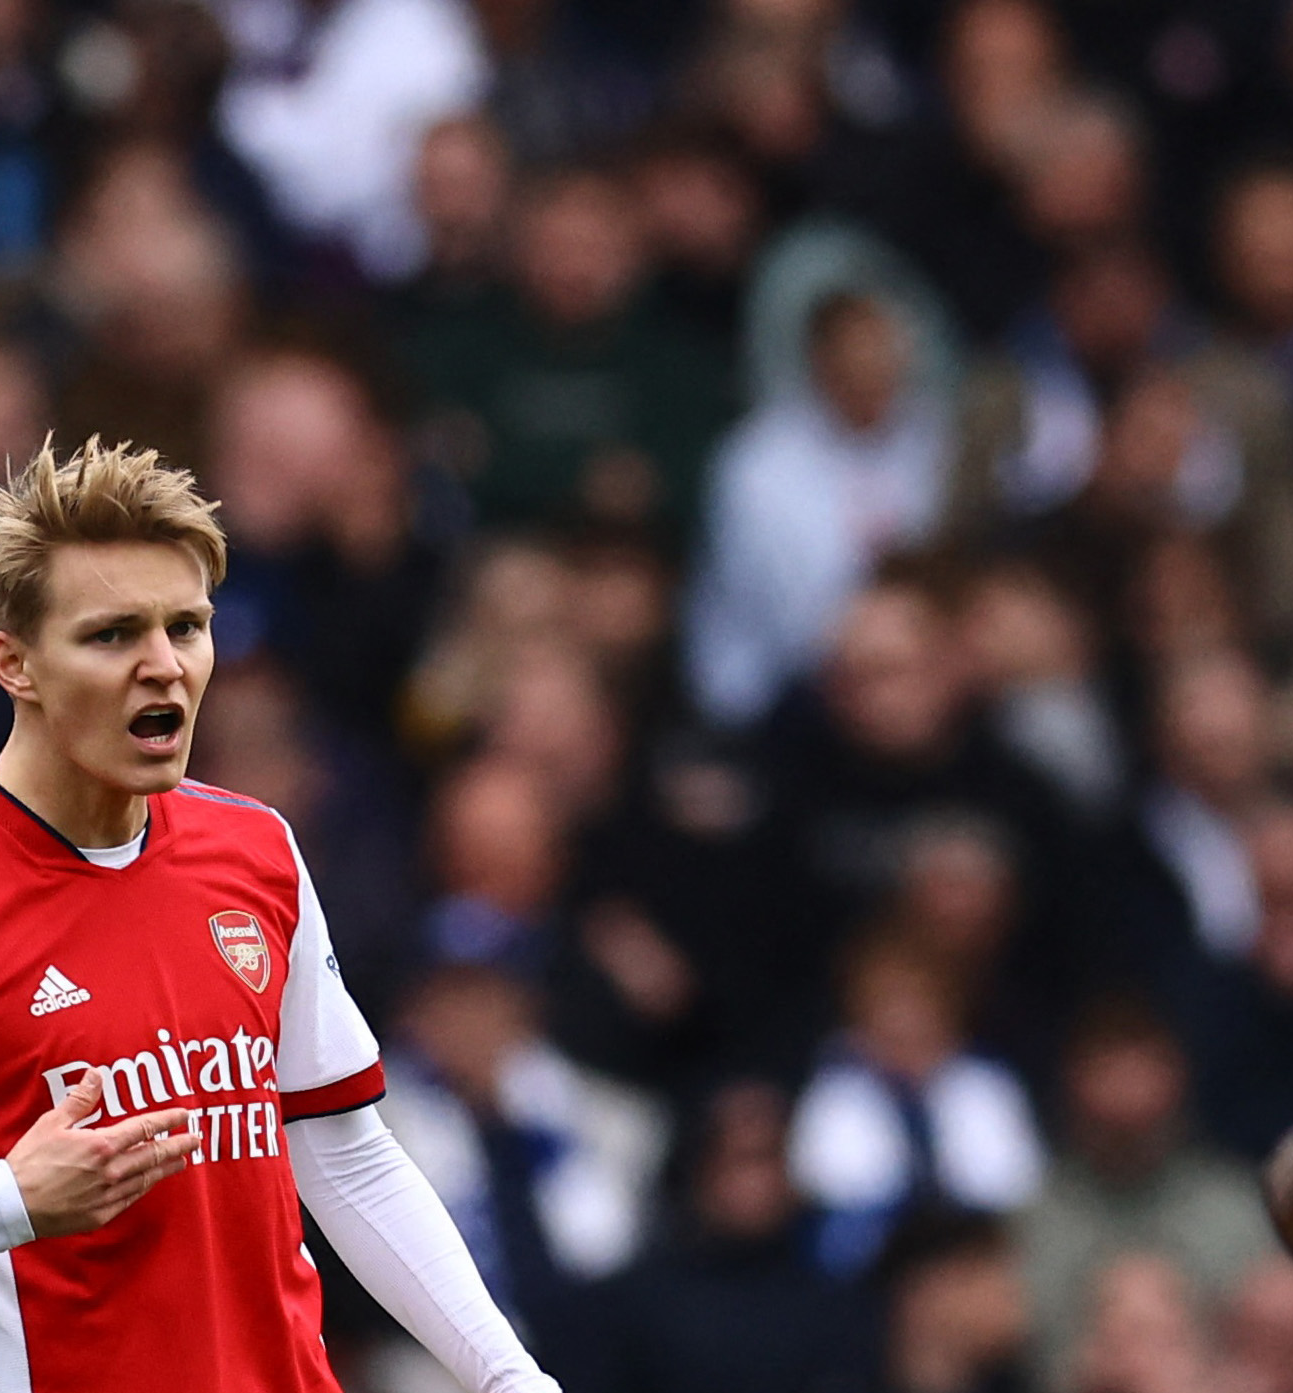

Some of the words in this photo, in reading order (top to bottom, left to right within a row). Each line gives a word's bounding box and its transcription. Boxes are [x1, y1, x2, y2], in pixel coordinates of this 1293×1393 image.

[218, 923, 259, 938] Arsenal
[29, 988, 92, 1017] adidas
[42, 1024, 277, 1130] Emirate
